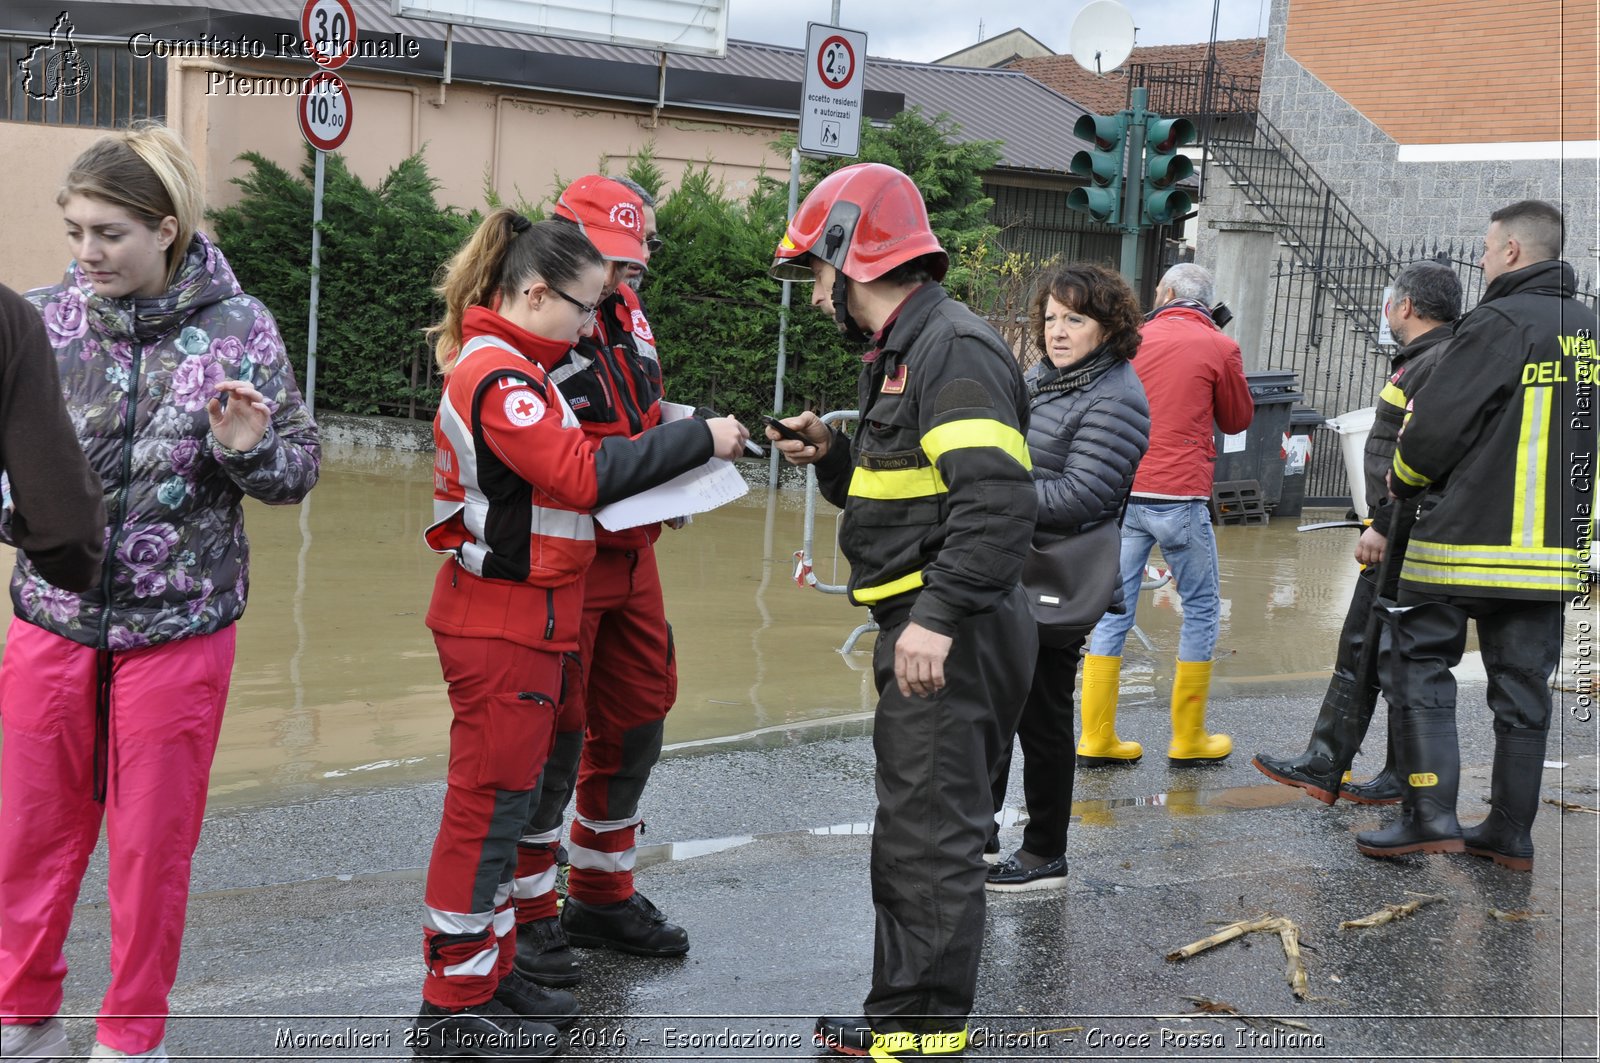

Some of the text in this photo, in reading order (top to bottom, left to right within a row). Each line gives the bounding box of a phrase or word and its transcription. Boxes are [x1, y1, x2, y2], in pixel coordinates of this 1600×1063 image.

[315, 8, 346, 48] 30
[808, 93, 858, 108] eccetto residenti
[814, 107, 851, 120] e autorizzati
[1521, 361, 1568, 385] DEL
[876, 458, 908, 468] TORINO
